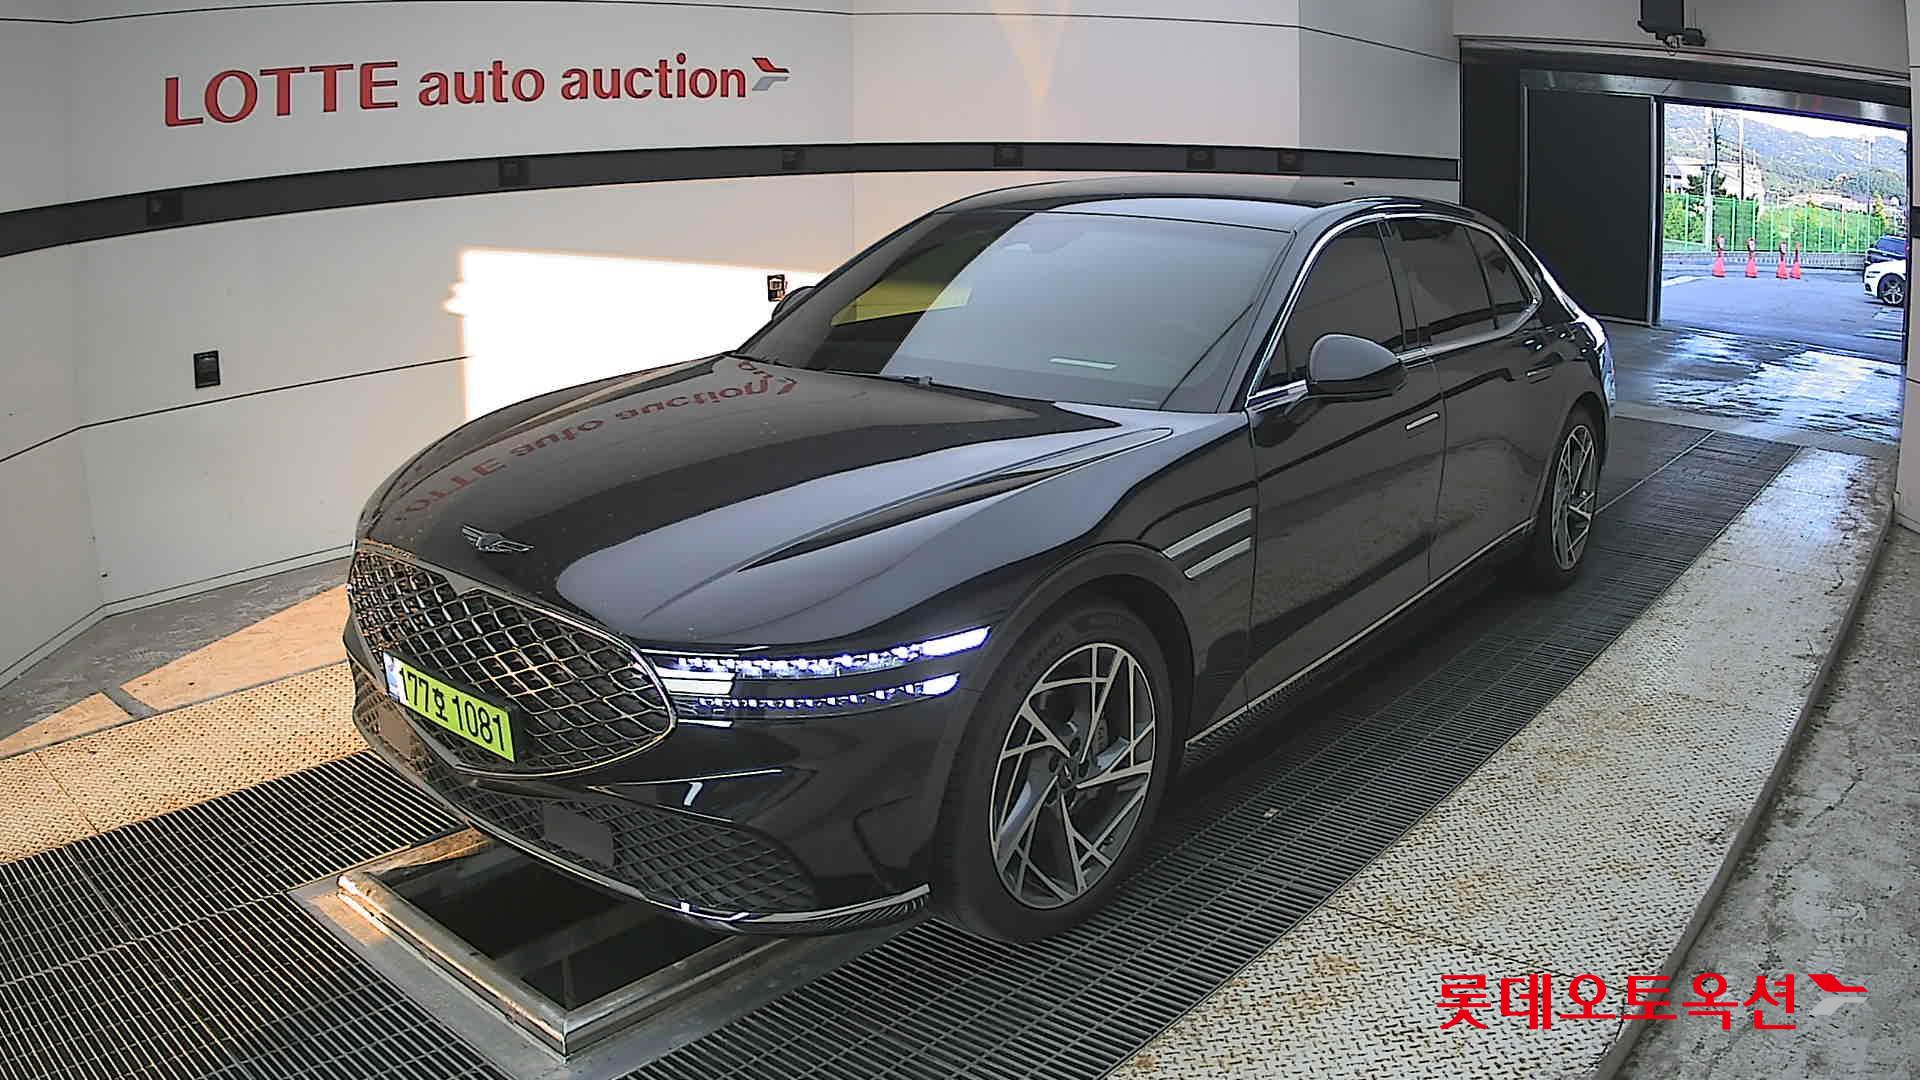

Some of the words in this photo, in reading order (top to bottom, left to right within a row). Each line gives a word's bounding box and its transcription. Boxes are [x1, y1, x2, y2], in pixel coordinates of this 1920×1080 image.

[165, 61, 399, 127] LOTTE
[418, 60, 546, 107] auto
[561, 52, 748, 100] auction
[400, 667, 448, 723] 177호
[452, 695, 505, 752] 1081
